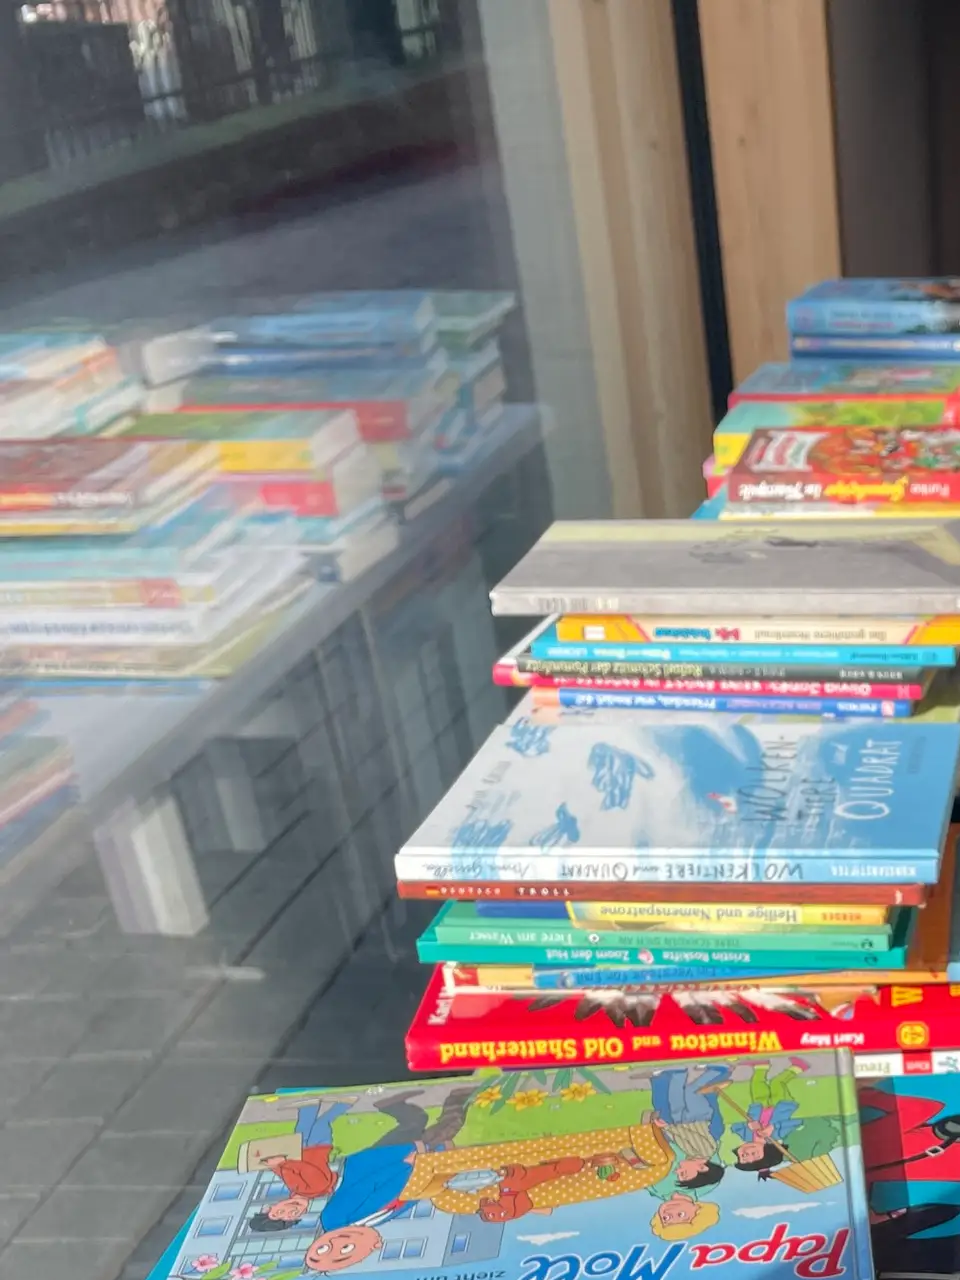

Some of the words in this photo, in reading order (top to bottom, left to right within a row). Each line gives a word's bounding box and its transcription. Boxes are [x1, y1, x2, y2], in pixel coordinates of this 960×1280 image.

[833, 739, 901, 820] QUADRAT
[560, 863, 629, 881] QUADRAT
[716, 908, 743, 921] und
[745, 908, 798, 923] Heilige
[515, 932, 537, 943] am
[540, 932, 574, 945] Tiere
[712, 951, 751, 962] Kristin
[633, 1036, 661, 1050] und
[670, 1030, 783, 1052] Winnetou
[801, 1032, 832, 1045] May
[834, 1033, 865, 1046] Karl
[440, 1038, 578, 1063] Shatterhand
[584, 1037, 624, 1058] Old
[689, 1223, 850, 1279] Papa
